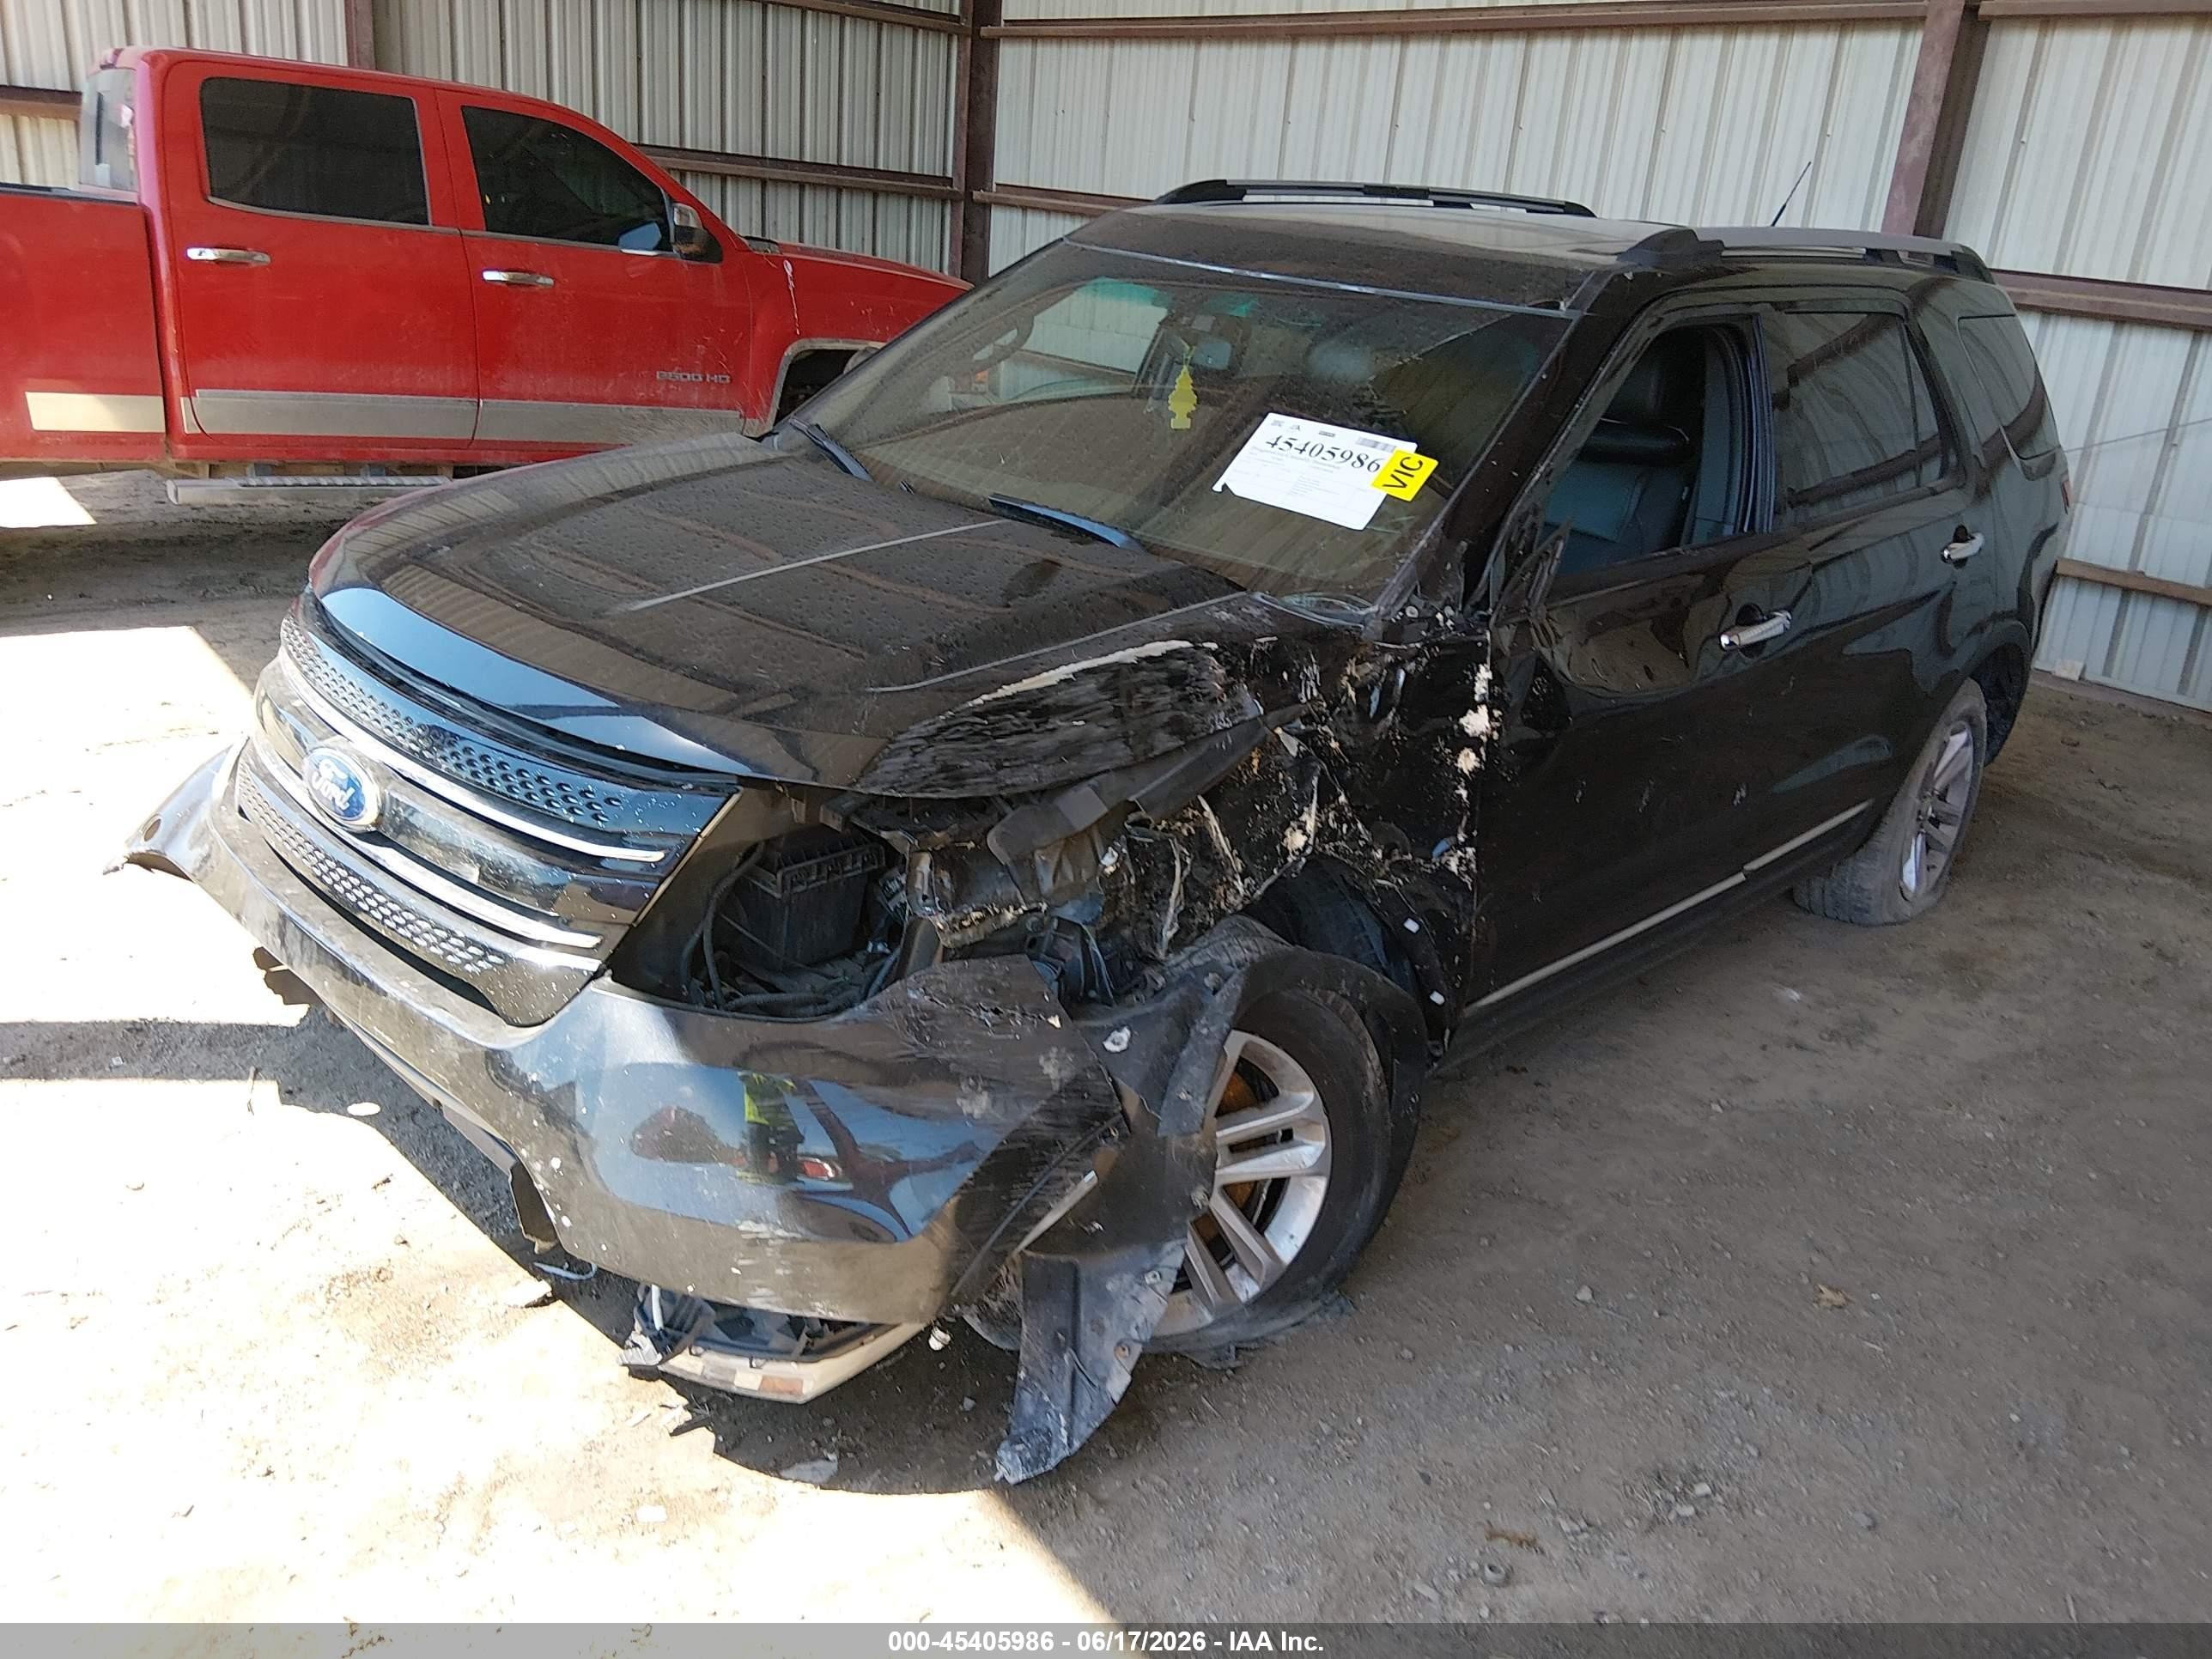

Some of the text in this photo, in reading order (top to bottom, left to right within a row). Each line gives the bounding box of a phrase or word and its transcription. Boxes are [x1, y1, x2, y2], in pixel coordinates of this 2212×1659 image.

[706, 374, 731, 385] HD
[1266, 434, 1384, 473] 45405986
[1382, 456, 1424, 489] VIC
[311, 758, 356, 811] Ford
